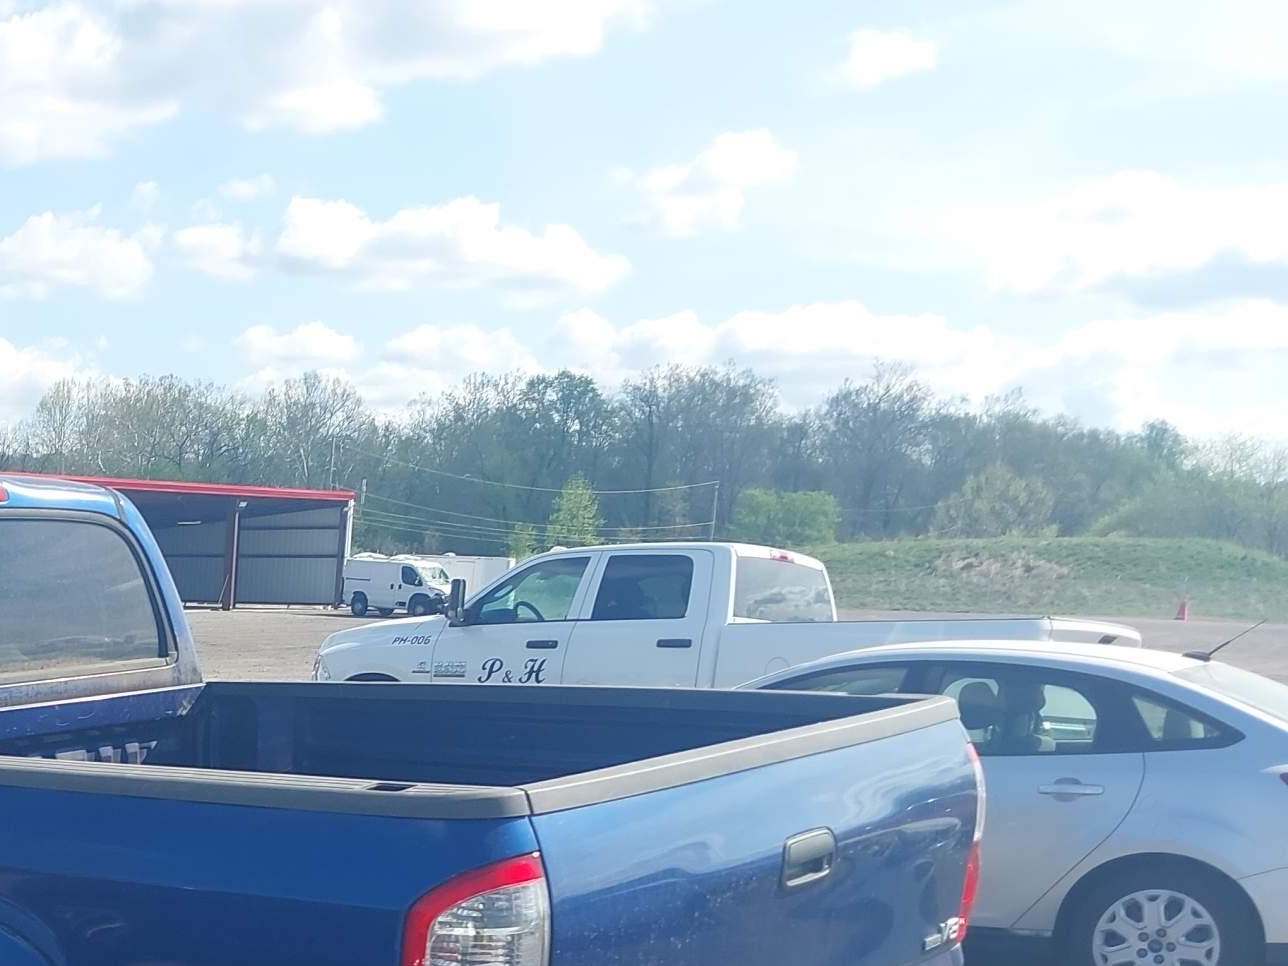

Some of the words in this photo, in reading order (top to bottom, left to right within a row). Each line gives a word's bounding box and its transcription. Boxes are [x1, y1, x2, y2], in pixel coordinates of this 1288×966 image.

[392, 635, 432, 645] PH-006
[478, 657, 504, 684] P
[502, 669, 513, 684] &
[518, 657, 547, 684] H
